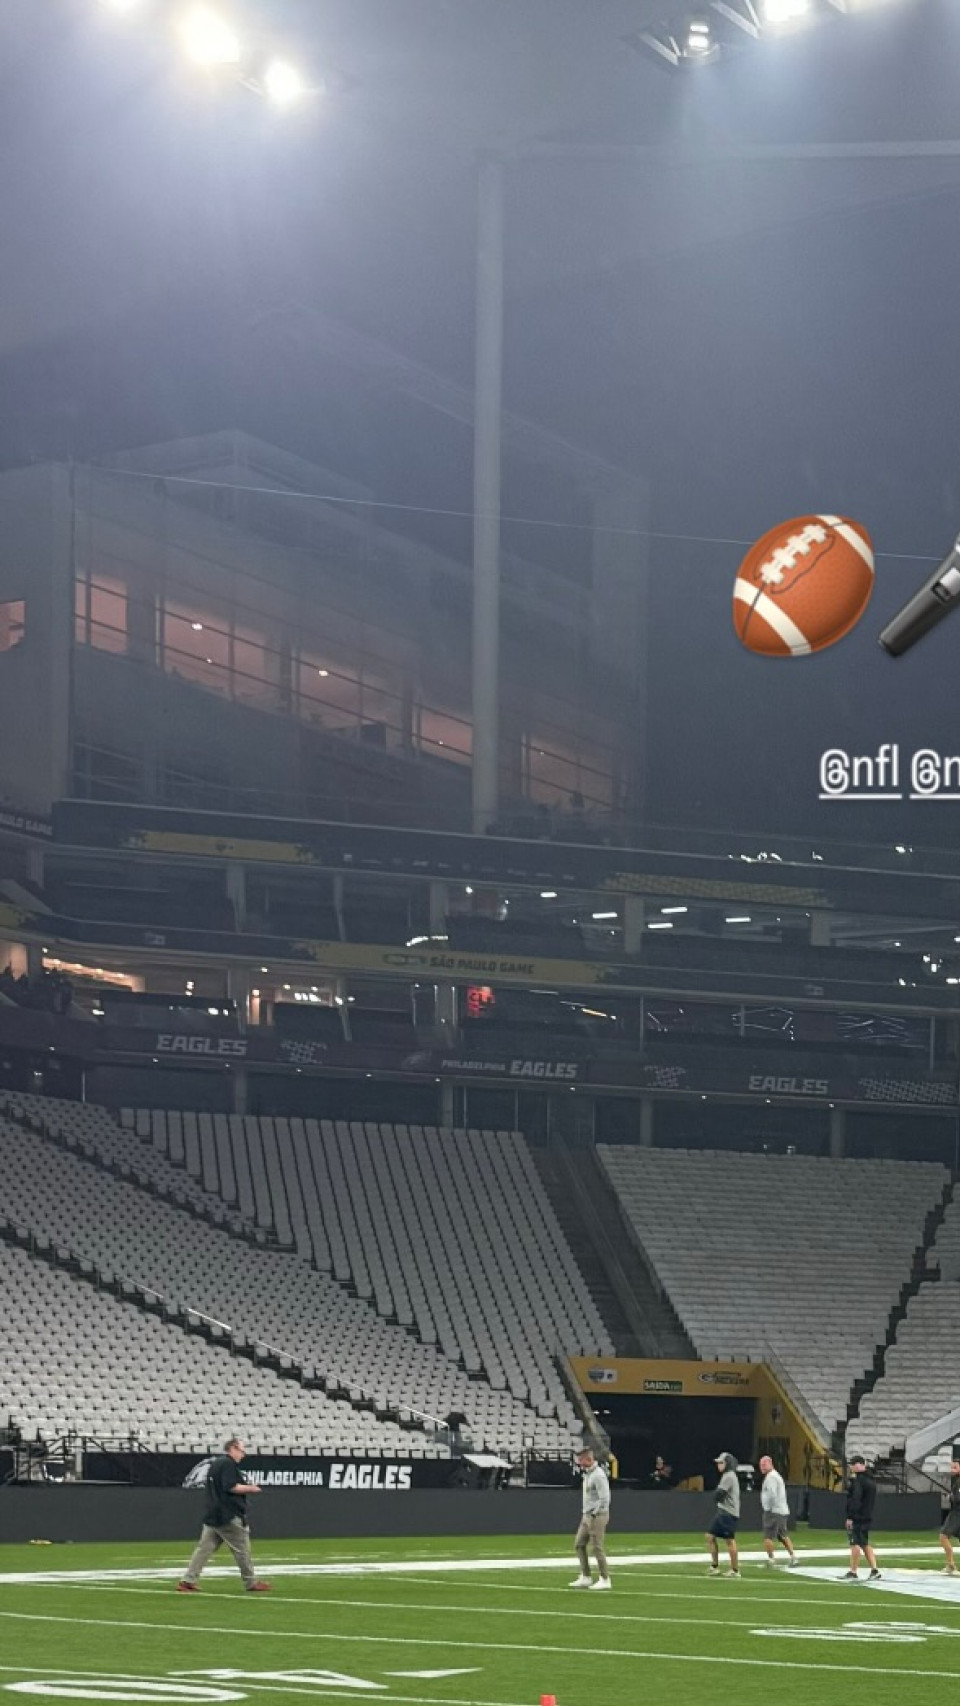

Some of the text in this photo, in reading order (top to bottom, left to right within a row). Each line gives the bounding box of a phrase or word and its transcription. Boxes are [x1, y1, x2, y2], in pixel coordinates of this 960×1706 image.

[457, 958, 496, 972] PAULO
[500, 962, 535, 975] GAME
[156, 1034, 248, 1056] EAGLES
[509, 1060, 578, 1079] EAGLES
[748, 1076, 829, 1094] EAGLES
[329, 1464, 412, 1489] EAGLES
